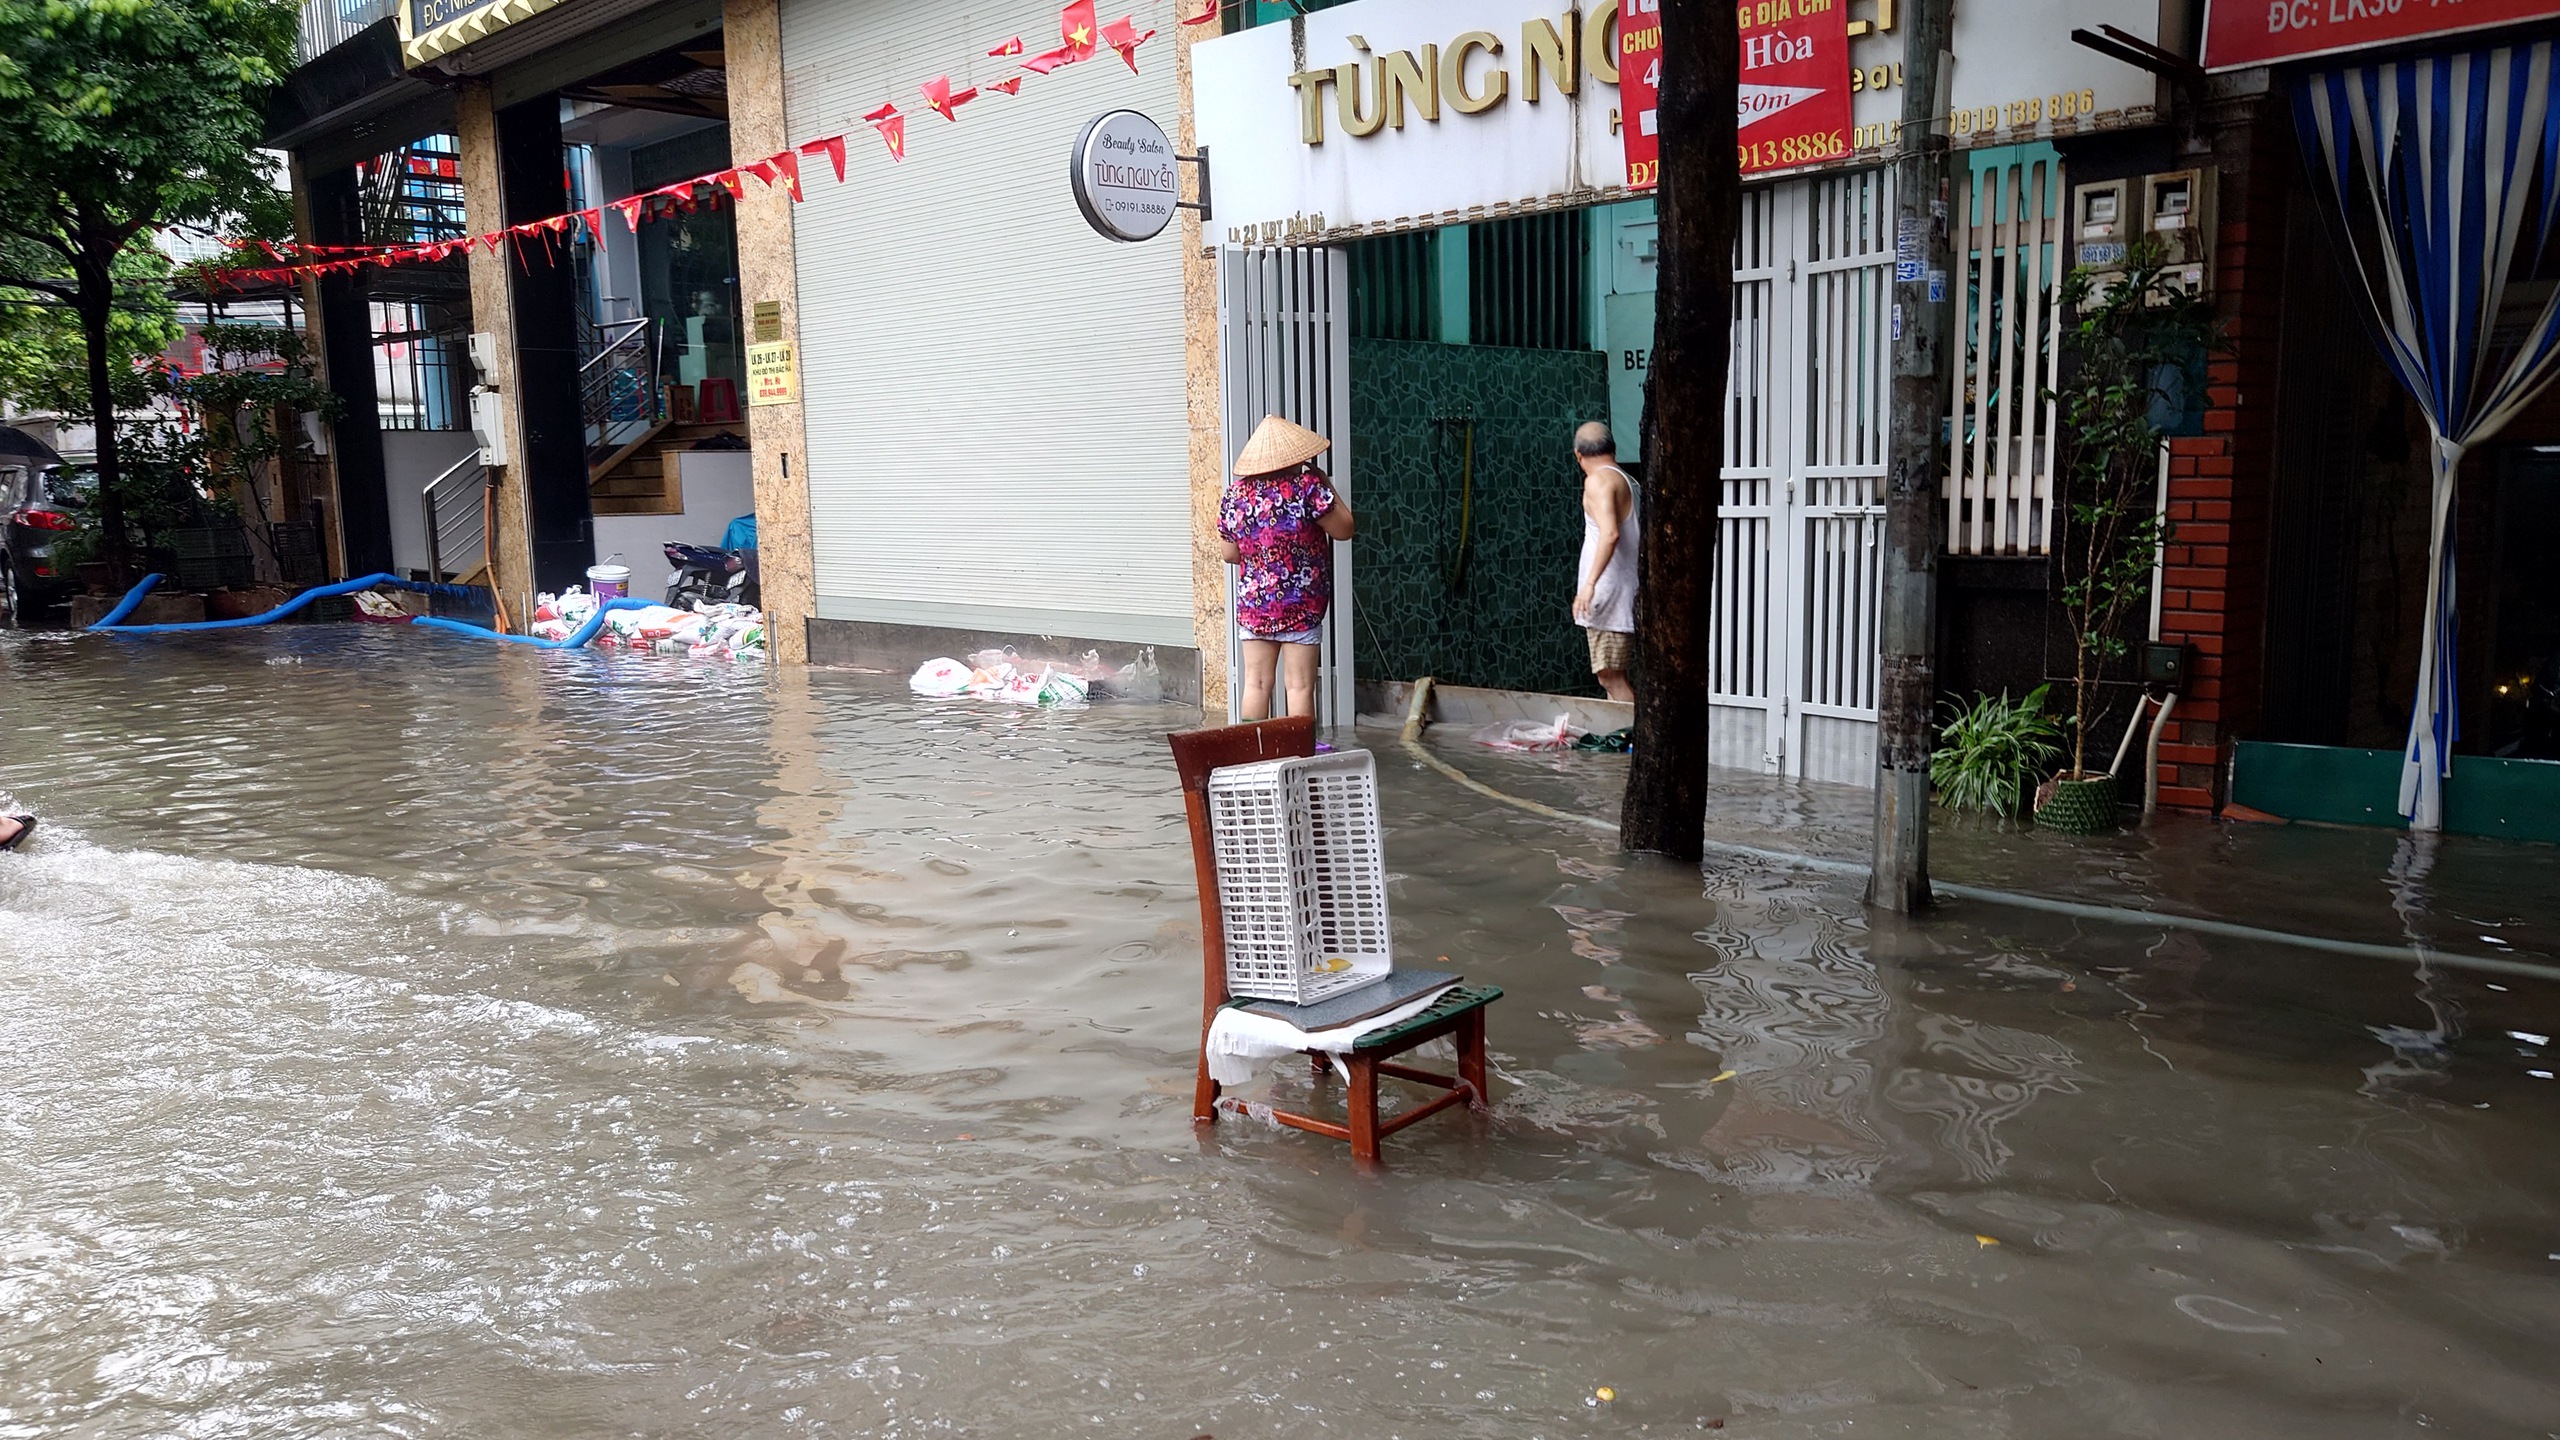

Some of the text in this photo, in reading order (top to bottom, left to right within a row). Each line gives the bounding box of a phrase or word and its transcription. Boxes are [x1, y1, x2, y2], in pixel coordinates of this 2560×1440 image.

[1757, 0, 1792, 28] ĐỊA
[2267, 1, 2319, 33] ĐC:
[1744, 31, 1814, 71] Hòa
[1288, 31, 1508, 145] TÙNG
[2004, 98, 2042, 127] 138
[2048, 88, 2094, 120] 886
[1102, 133, 1164, 155] Beauty Salon
[1115, 201, 1166, 215] 09191.38886
[1243, 223, 1257, 243] 29
[1624, 349, 1646, 371] BE
